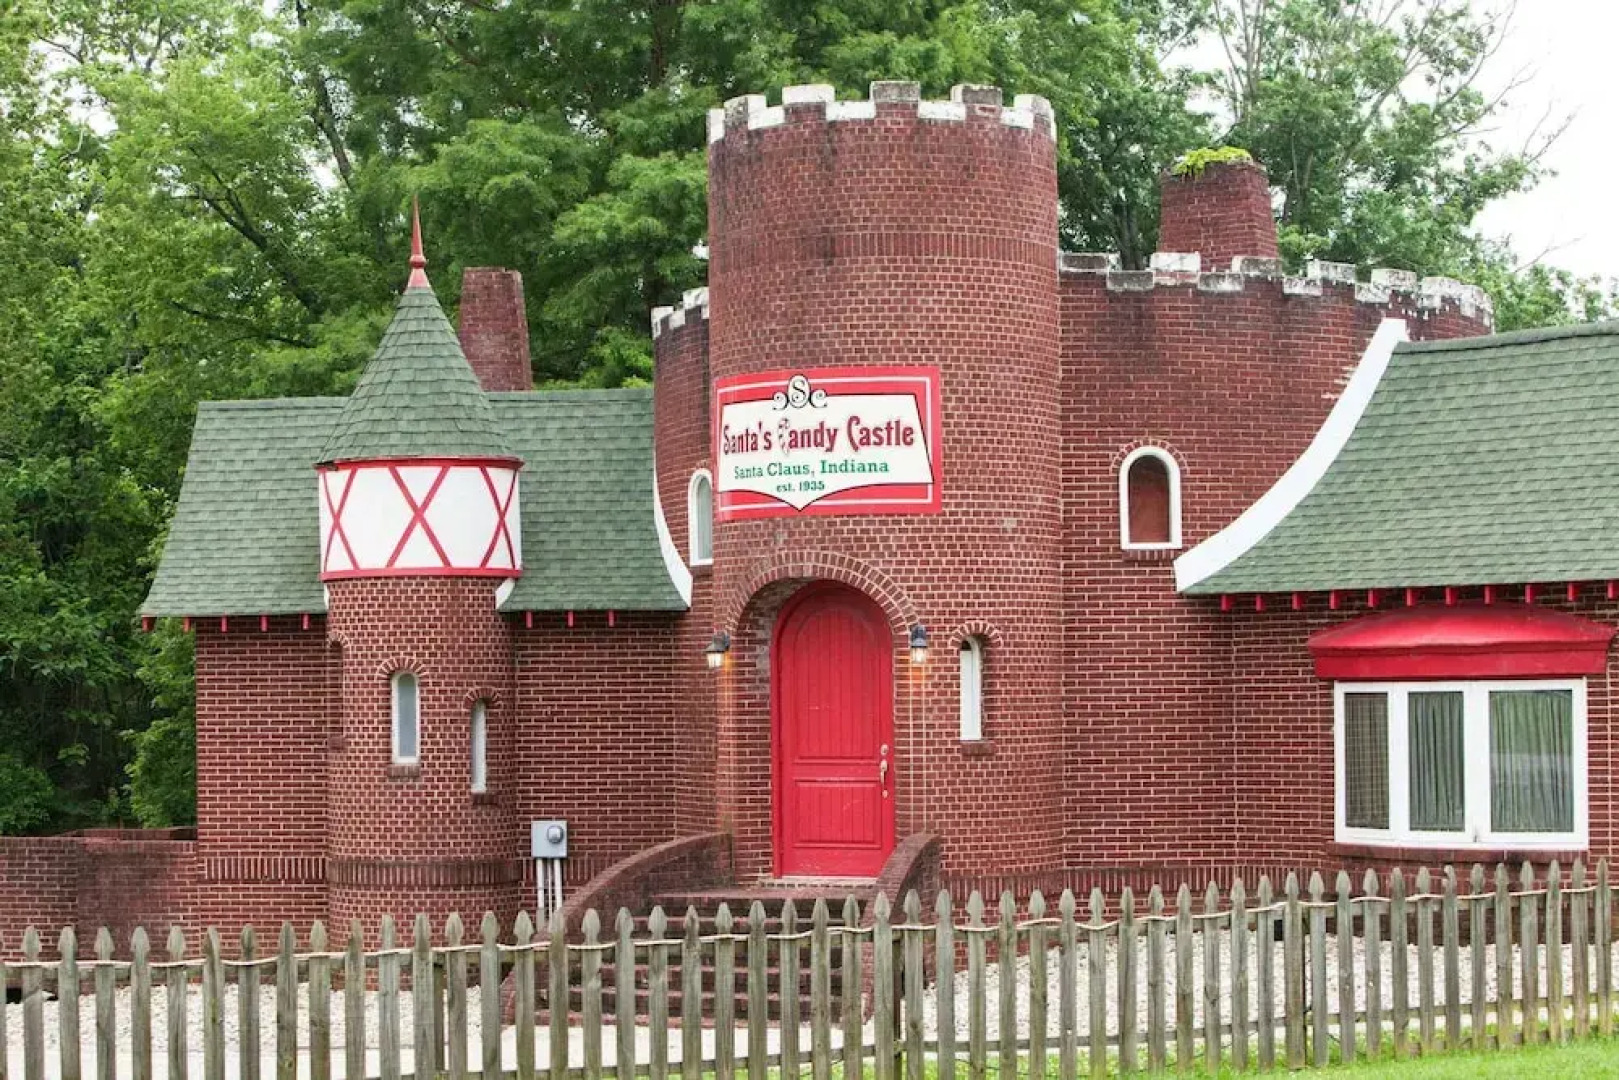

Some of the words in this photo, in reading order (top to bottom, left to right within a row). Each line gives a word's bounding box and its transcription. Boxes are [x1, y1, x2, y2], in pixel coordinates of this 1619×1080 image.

[723, 421, 772, 455] Santa's
[778, 418, 838, 455] Candy
[847, 416, 915, 452] Castle
[734, 464, 764, 480] Santa
[767, 461, 815, 477] Claus,
[820, 459, 890, 474] Indiana
[776, 483, 796, 493] est.
[799, 481, 825, 492] 1935
